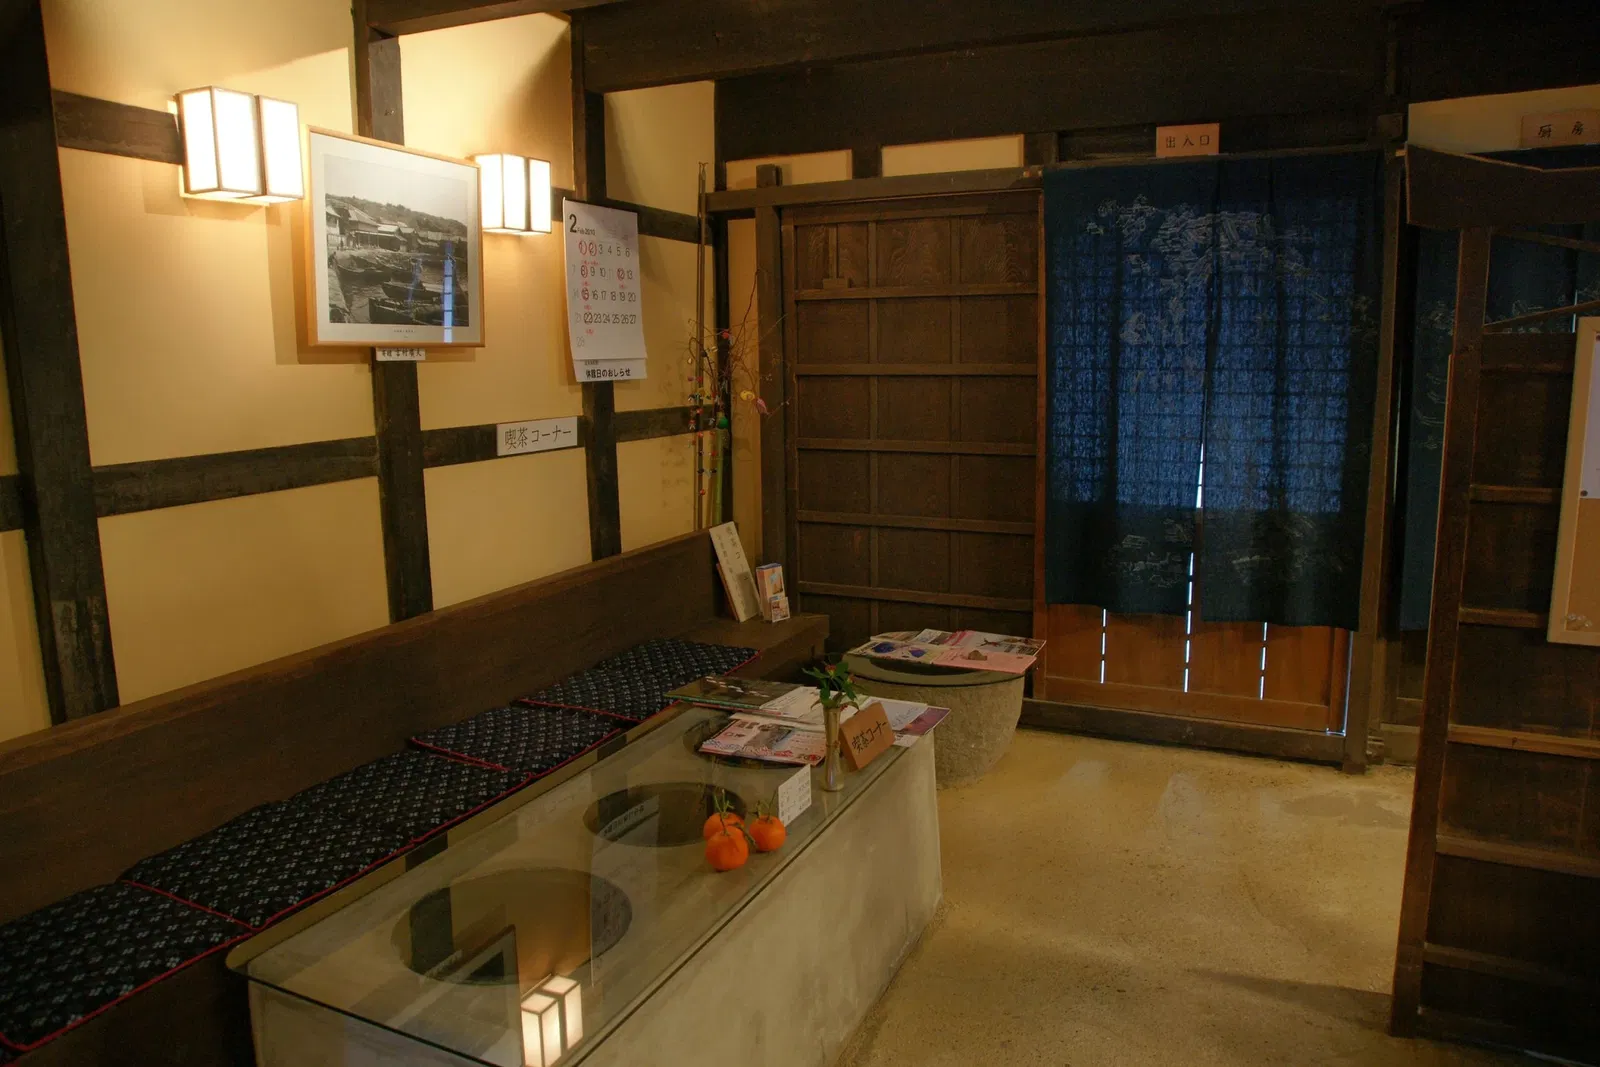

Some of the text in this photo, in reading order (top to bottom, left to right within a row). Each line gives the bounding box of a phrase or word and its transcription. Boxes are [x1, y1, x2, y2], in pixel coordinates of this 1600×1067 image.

[1537, 120, 1584, 141] 厨房
[1165, 135, 1210, 149] 出入口
[569, 213, 577, 233] 2
[598, 244, 603, 255] 3
[607, 246, 612, 255] 4
[616, 247, 621, 257] 5
[625, 248, 630, 258] 6
[590, 267, 596, 276] 9
[600, 268, 606, 277] 10
[627, 270, 633, 280] 13
[592, 289, 599, 300] 16
[601, 291, 607, 300] 17
[610, 291, 616, 301] 18
[619, 292, 625, 302] 19
[628, 292, 636, 302] 20
[584, 313, 593, 324] 22
[594, 313, 602, 324] 23
[603, 314, 611, 324] 24
[612, 314, 620, 324] 25
[621, 314, 629, 324] 26
[629, 314, 637, 324] 27
[504, 424, 572, 451] 喫茶コーナー
[851, 720, 888, 754] 喫茶コーナー
